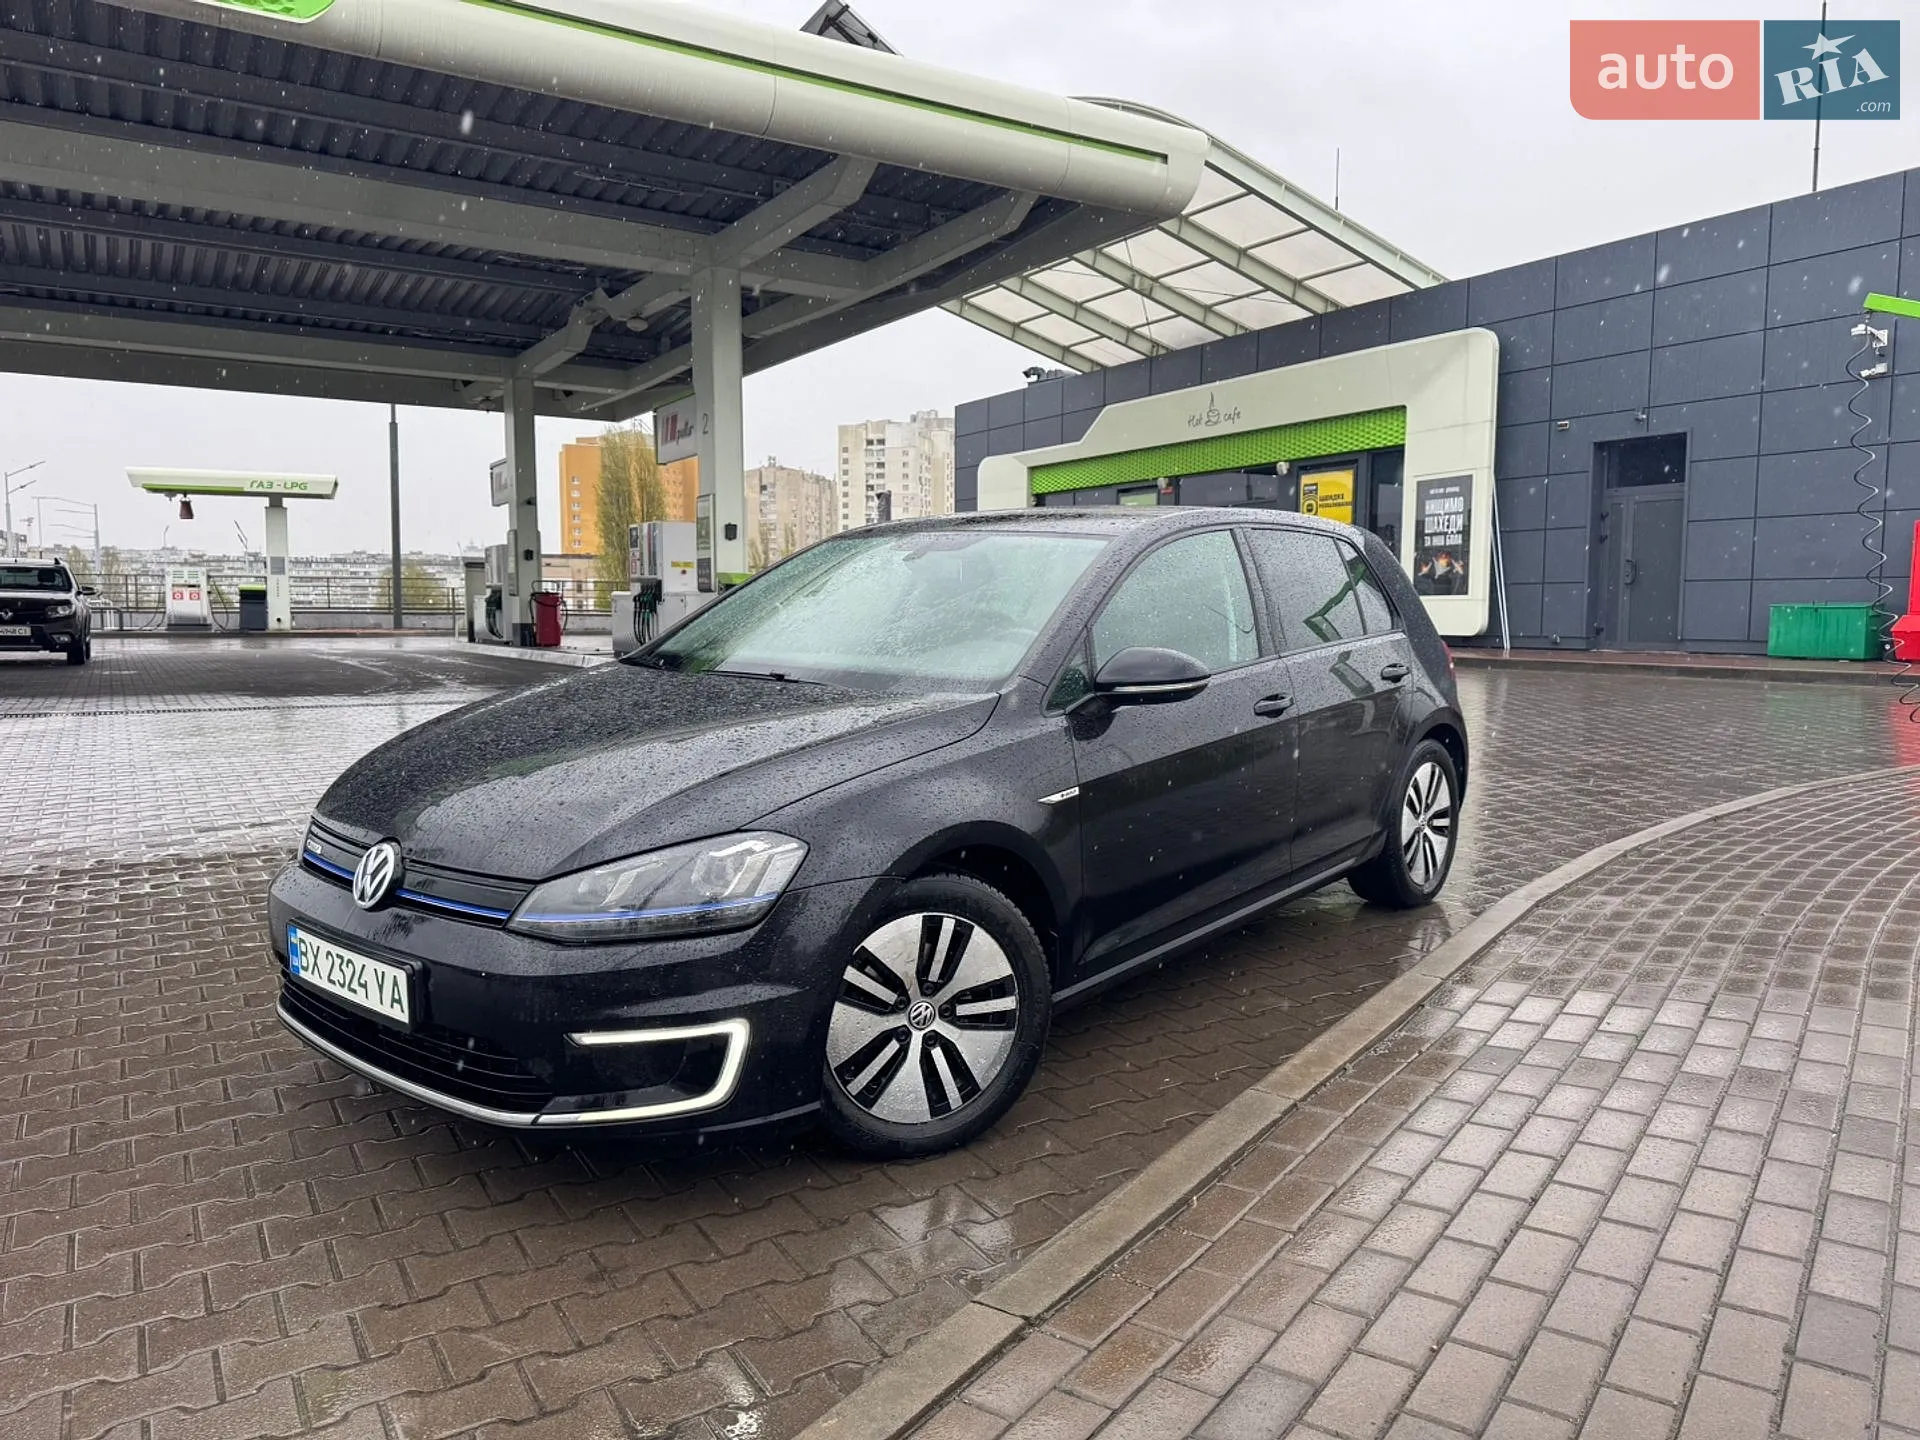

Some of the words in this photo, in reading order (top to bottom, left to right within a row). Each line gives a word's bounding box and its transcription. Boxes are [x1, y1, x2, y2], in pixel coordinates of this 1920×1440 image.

[702, 412, 710, 436] 2
[1223, 406, 1241, 424] cafe
[249, 479, 274, 489] ГАЗ
[283, 481, 309, 491] LPG
[1424, 513, 1464, 534] ШАХЕДИ
[298, 937, 322, 980] BX
[325, 950, 369, 1000] 2324
[374, 968, 405, 1014] YA
